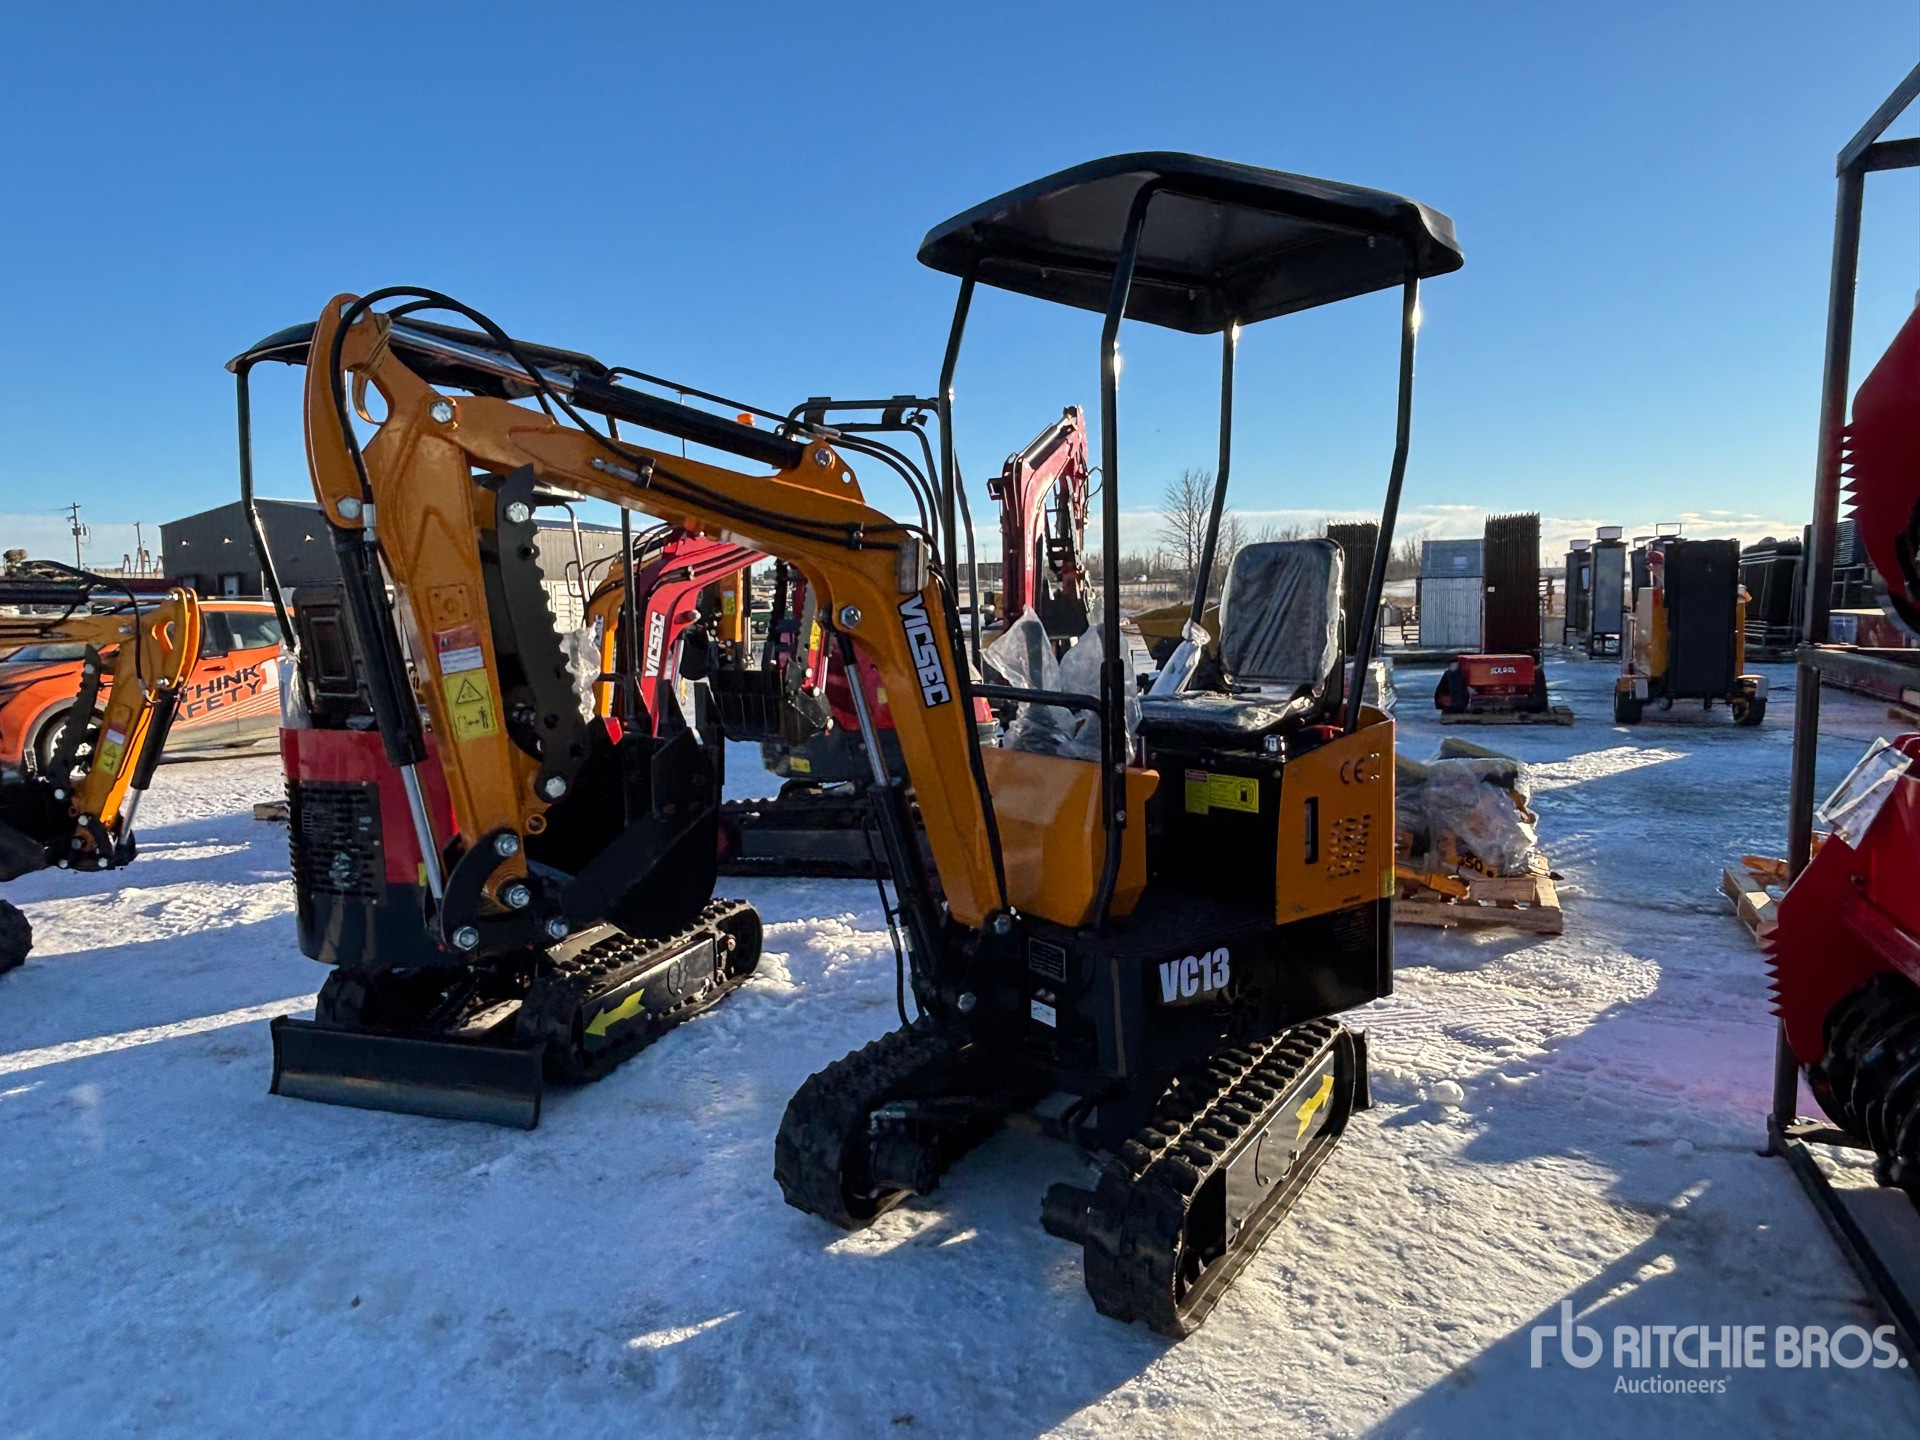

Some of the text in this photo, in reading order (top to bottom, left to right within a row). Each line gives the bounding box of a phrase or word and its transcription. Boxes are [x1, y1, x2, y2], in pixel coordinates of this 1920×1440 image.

[644, 611, 666, 678] VICSEC
[899, 592, 951, 707] VICSEC
[180, 664, 260, 704] THINK
[1158, 947, 1230, 1003] VC13
